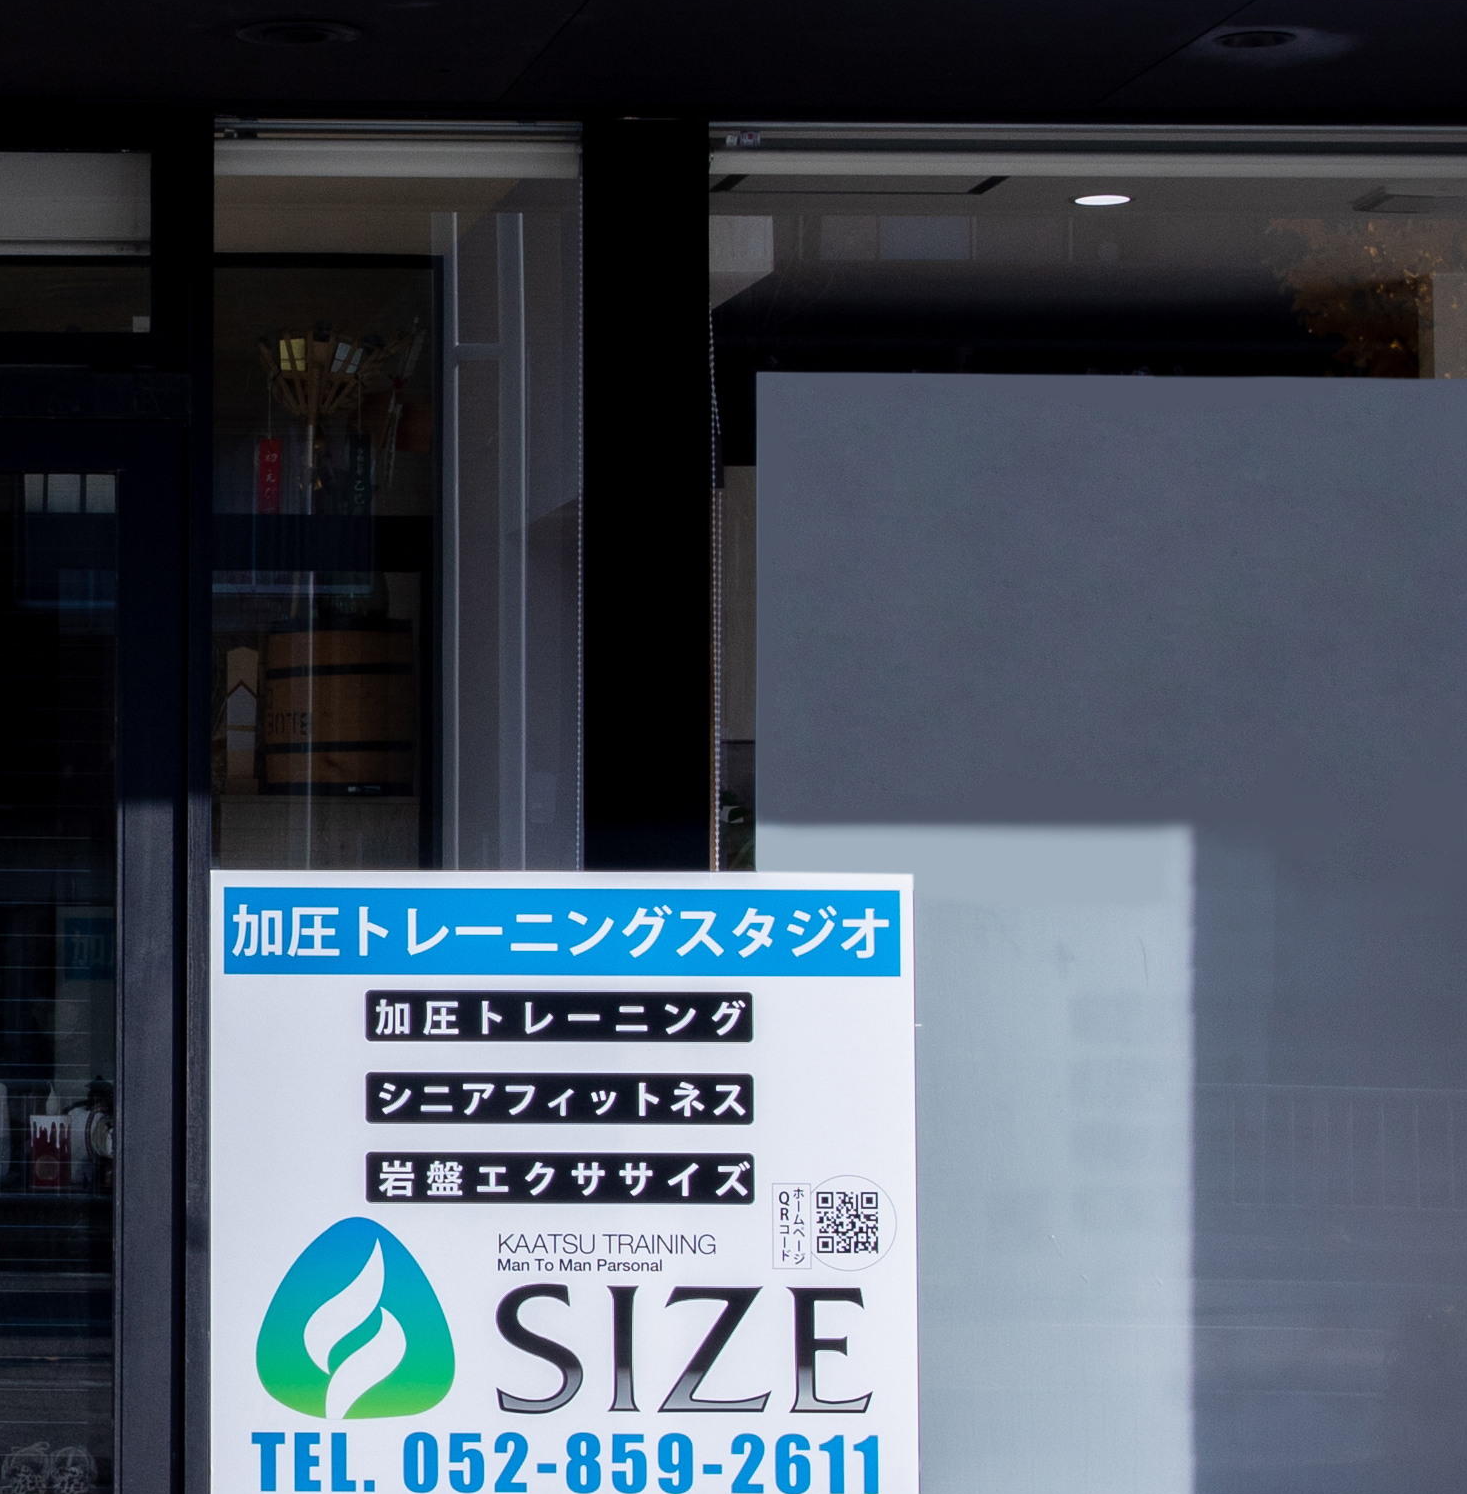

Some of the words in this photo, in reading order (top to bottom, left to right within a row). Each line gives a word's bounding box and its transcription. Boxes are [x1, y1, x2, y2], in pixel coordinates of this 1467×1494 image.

[231, 902, 891, 962] 加圧トレーニングスタジオ
[375, 999, 746, 1038] 加圧トレーニング
[377, 1079, 748, 1119] シニアフィットネス
[378, 1159, 752, 1199] 岩盤エクササイズ
[497, 1233, 596, 1256] KAATSU
[602, 1233, 717, 1256] TRAINING
[778, 1191, 791, 1262] QRコード
[793, 1187, 806, 1265] ホームページ
[497, 1258, 531, 1273] Man
[534, 1258, 555, 1273] To
[558, 1258, 592, 1273] Man
[596, 1258, 664, 1273] Parsonal
[495, 1283, 875, 1414] SIZE
[251, 1431, 376, 1493] TEL.
